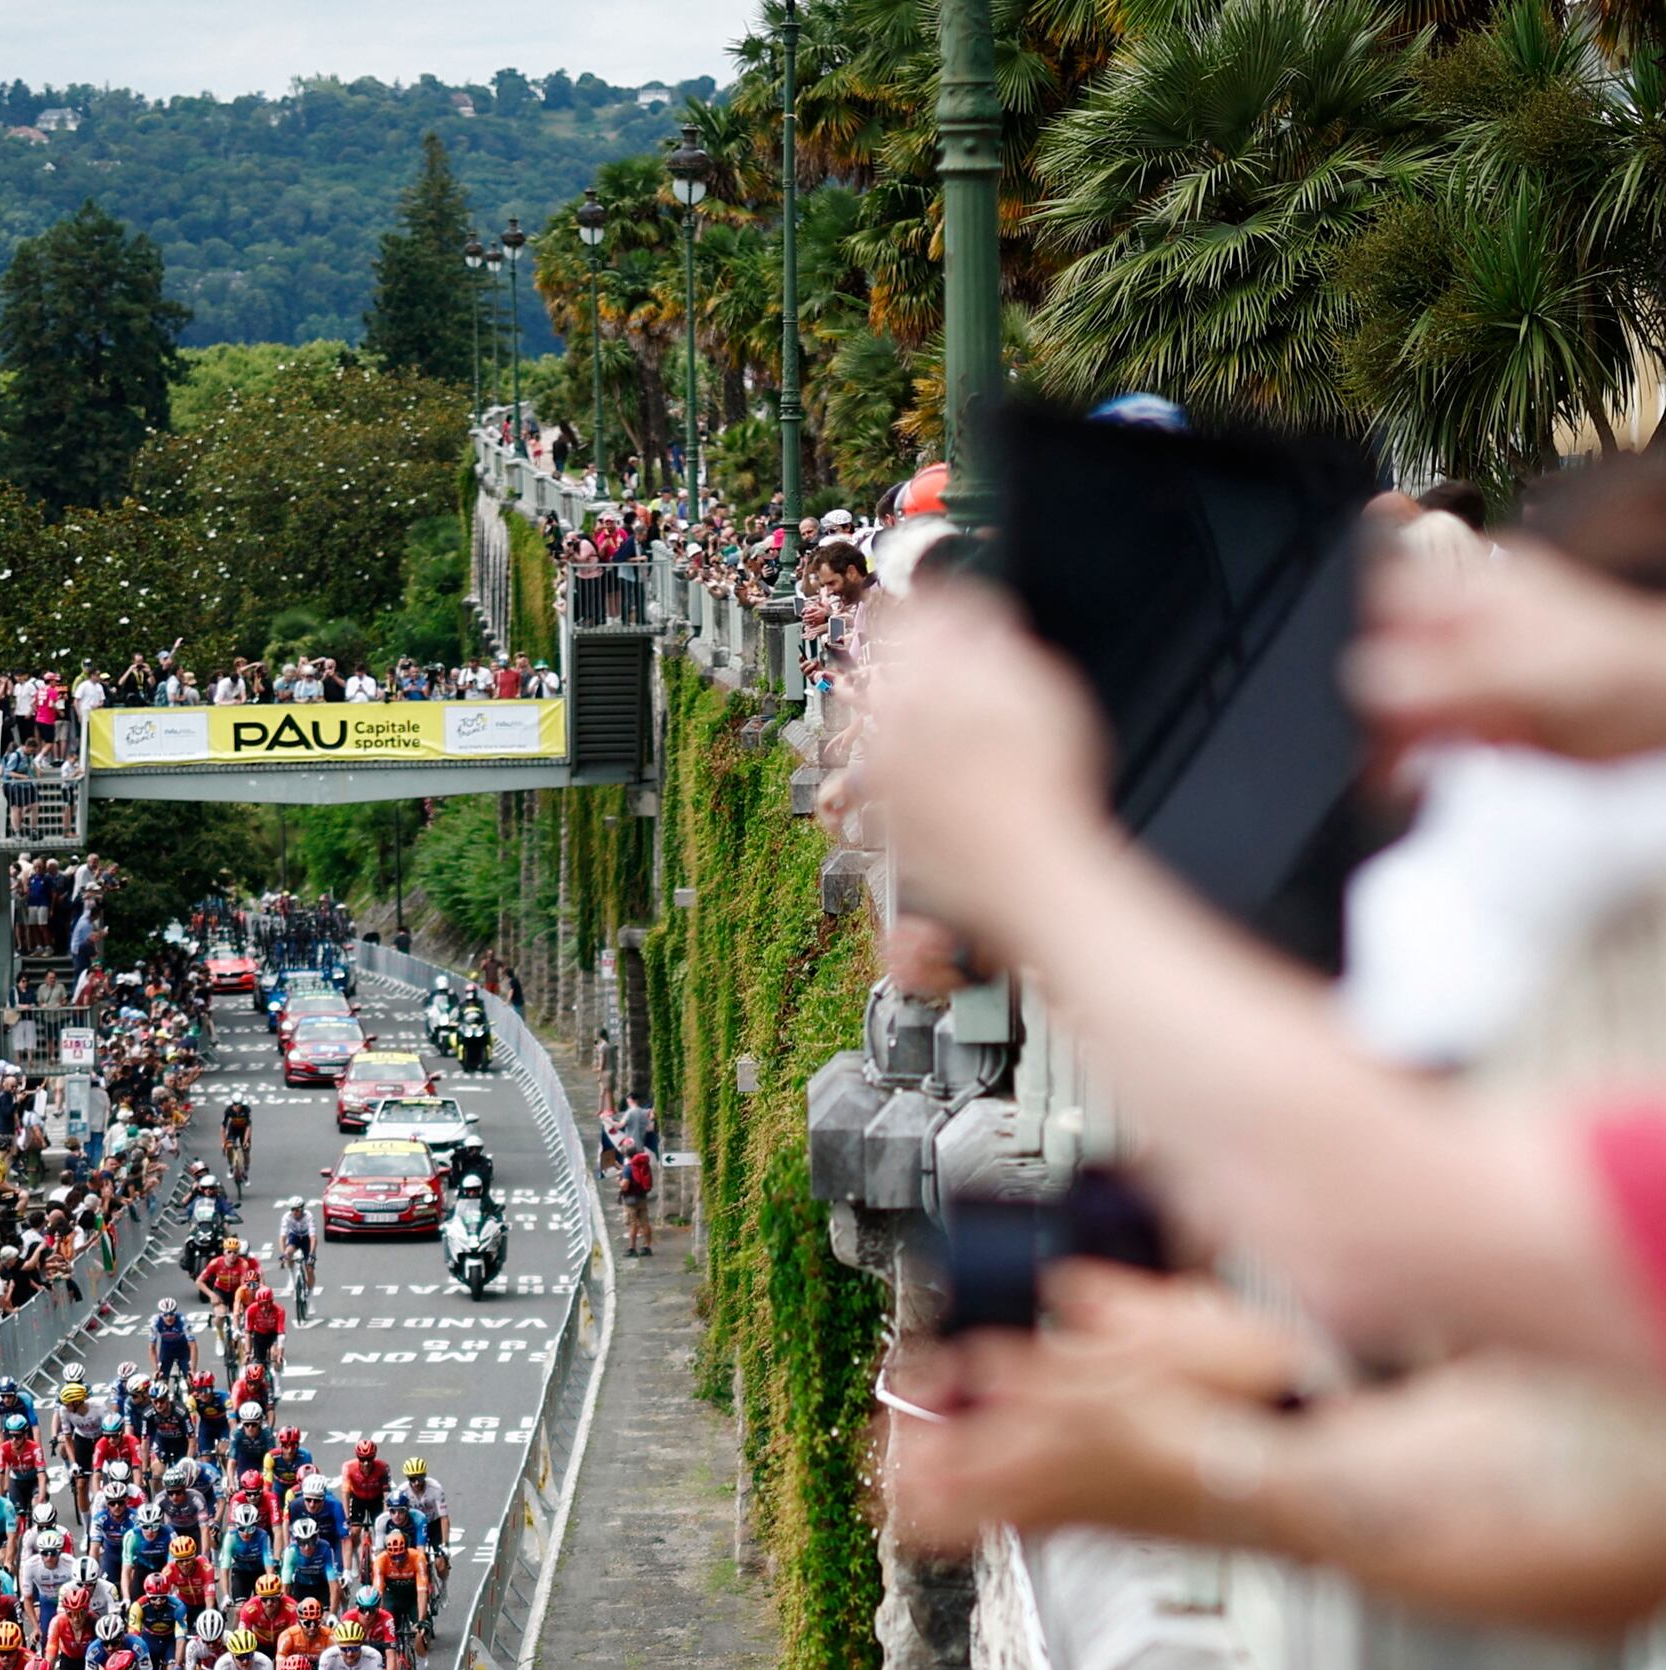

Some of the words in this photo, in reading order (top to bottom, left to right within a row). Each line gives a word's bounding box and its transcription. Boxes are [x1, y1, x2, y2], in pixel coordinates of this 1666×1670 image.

[232, 713, 348, 752] PAU
[354, 720, 420, 736] Capitale
[355, 736, 421, 752] sportive
